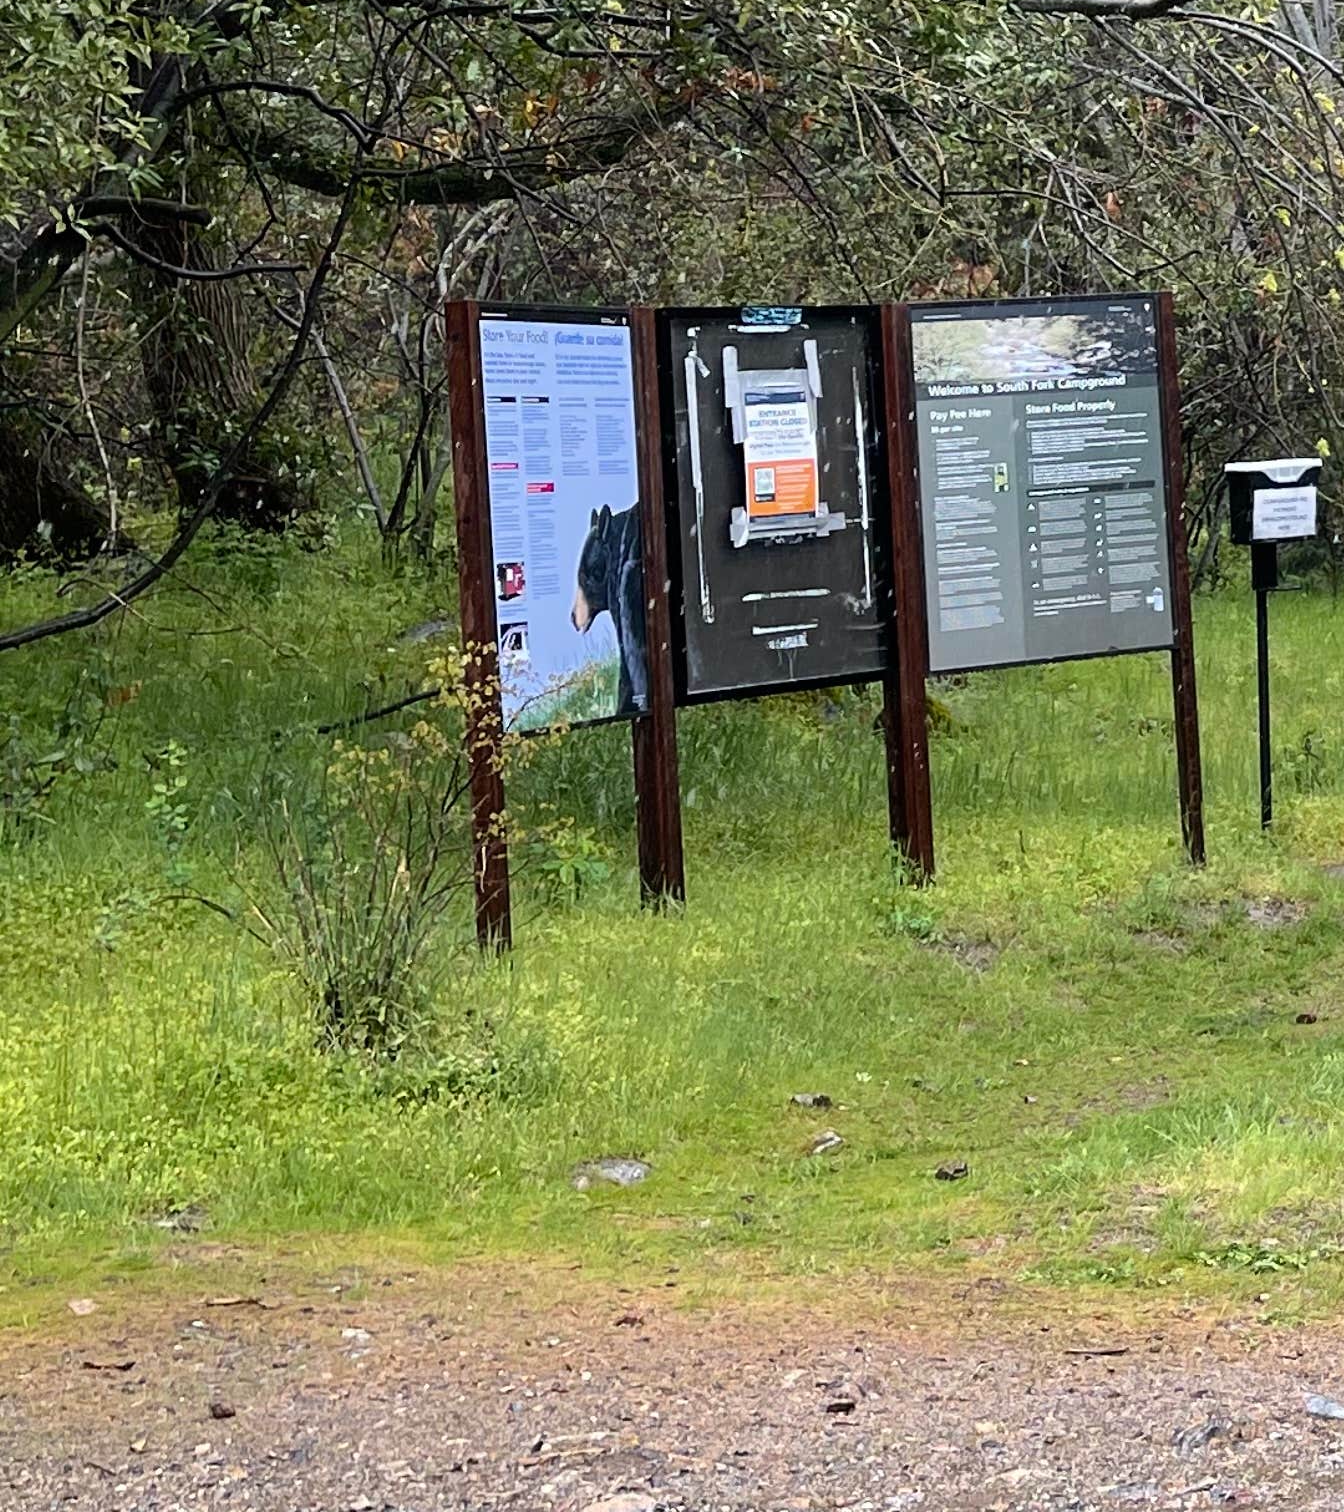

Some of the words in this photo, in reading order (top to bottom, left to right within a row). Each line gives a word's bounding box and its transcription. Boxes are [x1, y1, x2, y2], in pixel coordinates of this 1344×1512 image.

[505, 329, 524, 343] Your
[928, 384, 979, 397] Welcome
[981, 384, 994, 395] to
[997, 380, 1029, 393] South
[1031, 379, 1055, 391] Fork
[1058, 375, 1126, 392] Campground
[1026, 404, 1051, 415] Store
[1052, 402, 1076, 413] Food
[1077, 399, 1116, 412] Properly
[930, 410, 948, 423] Pay
[949, 409, 967, 419] Fee
[968, 408, 992, 418] Here
